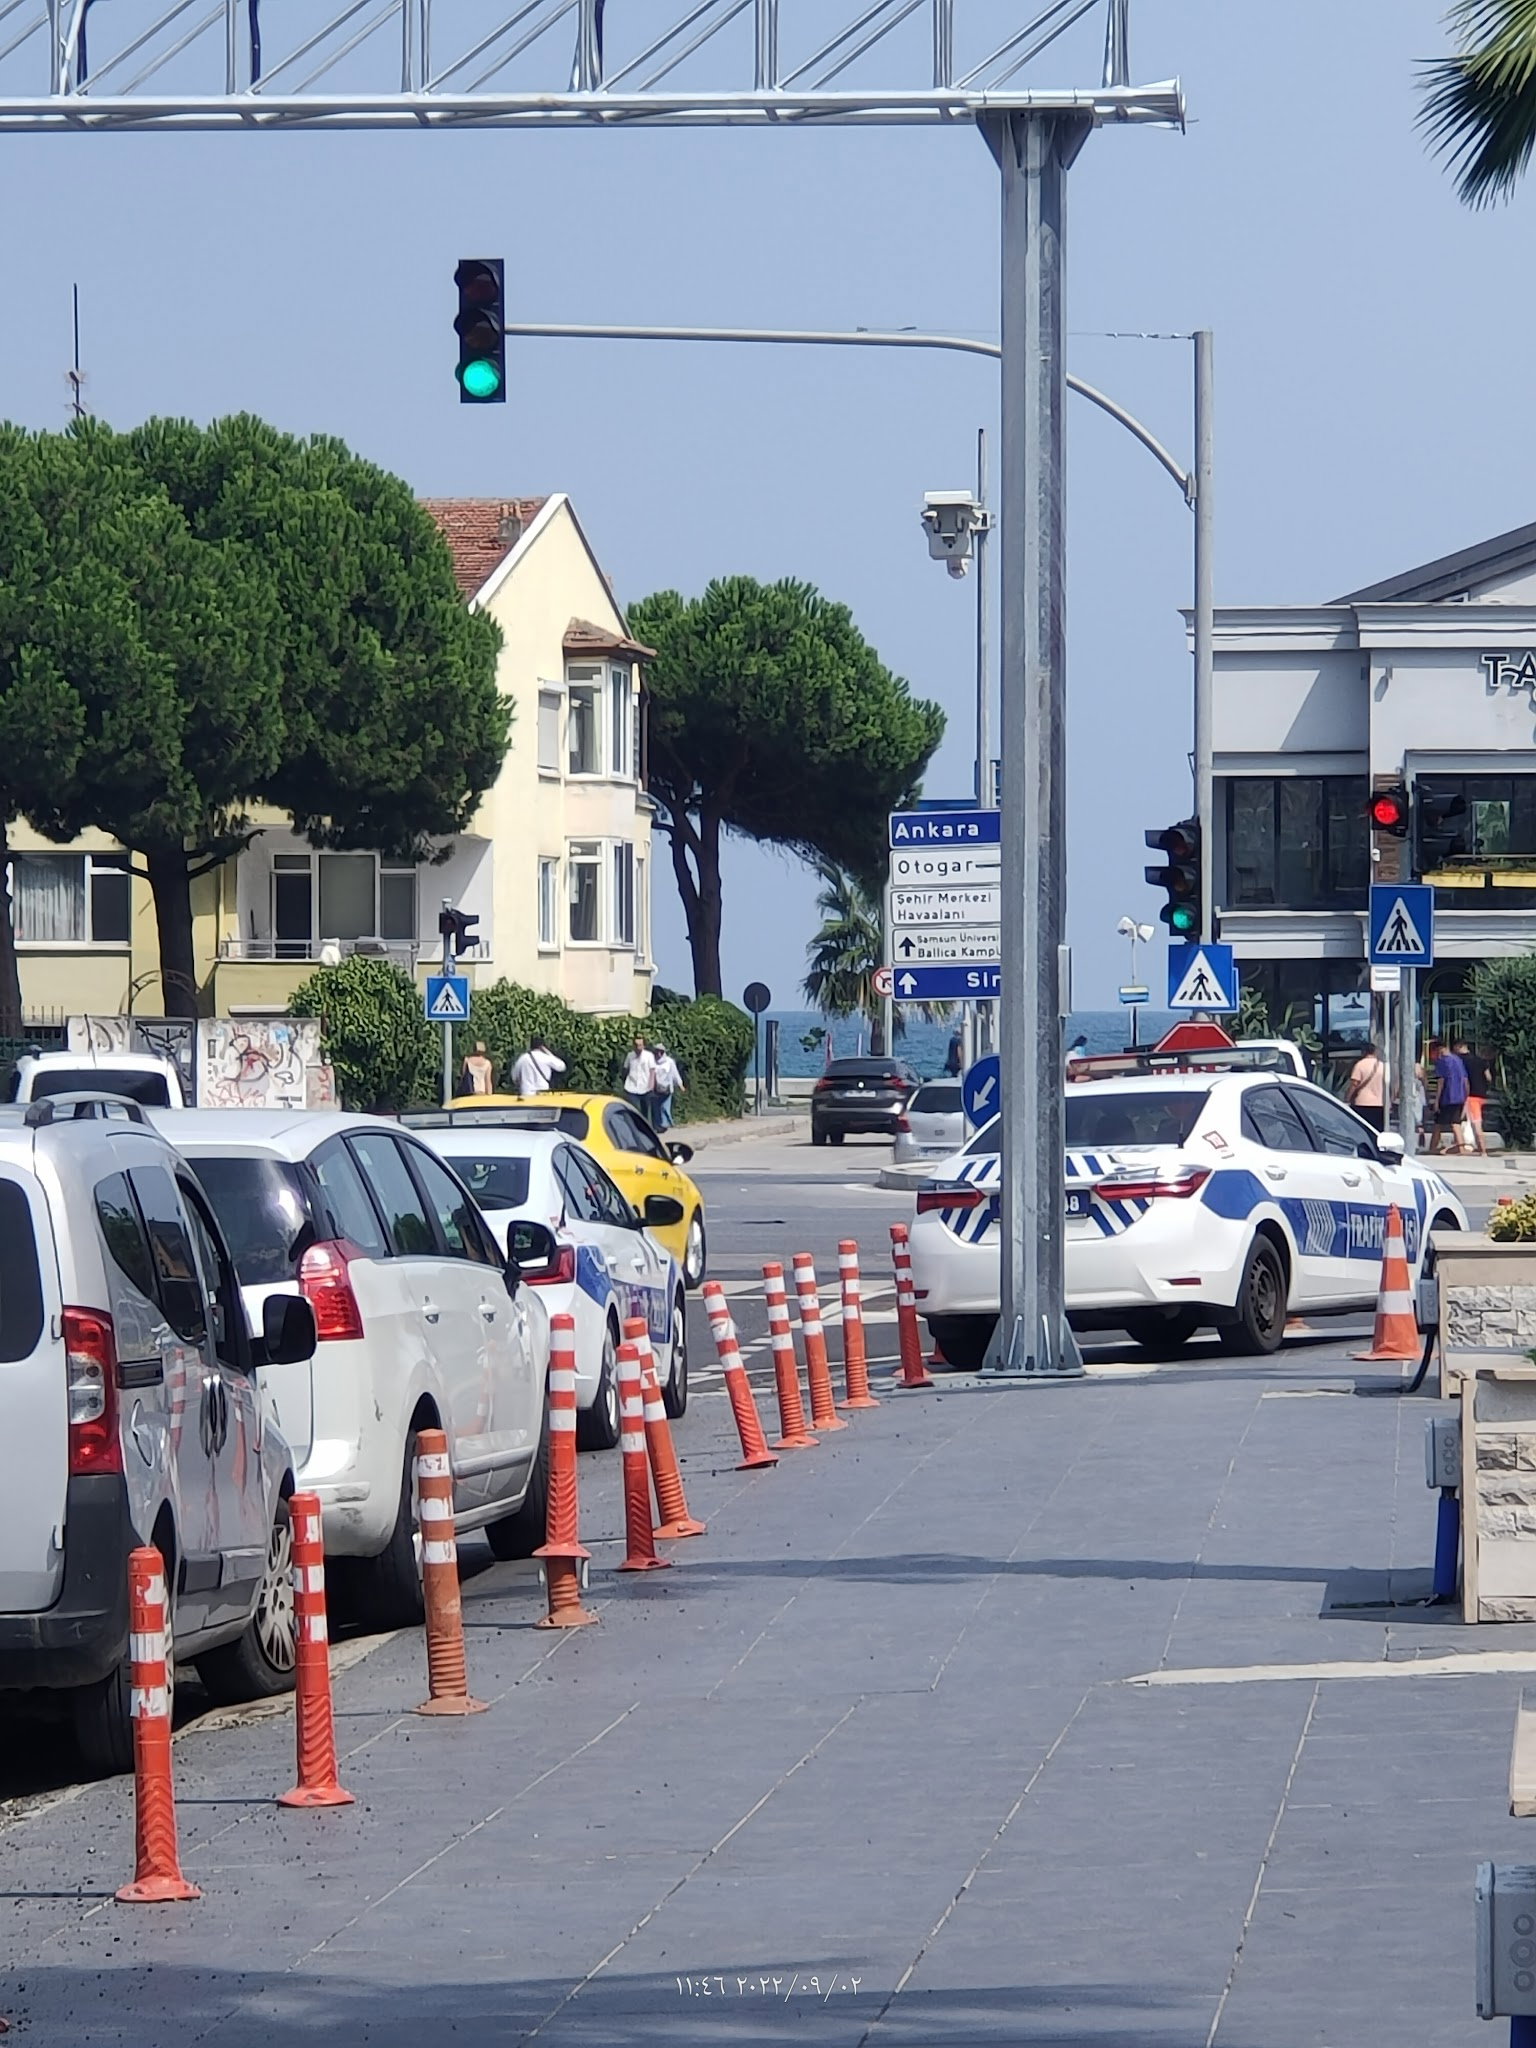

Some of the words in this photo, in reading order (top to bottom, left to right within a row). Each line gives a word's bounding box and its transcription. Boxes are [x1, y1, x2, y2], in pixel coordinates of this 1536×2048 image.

[895, 822, 979, 839] Ankara
[898, 860, 973, 876] Otogar
[897, 893, 933, 905] Şehir
[938, 892, 991, 904] Merkezi
[917, 935, 957, 944] Samsun
